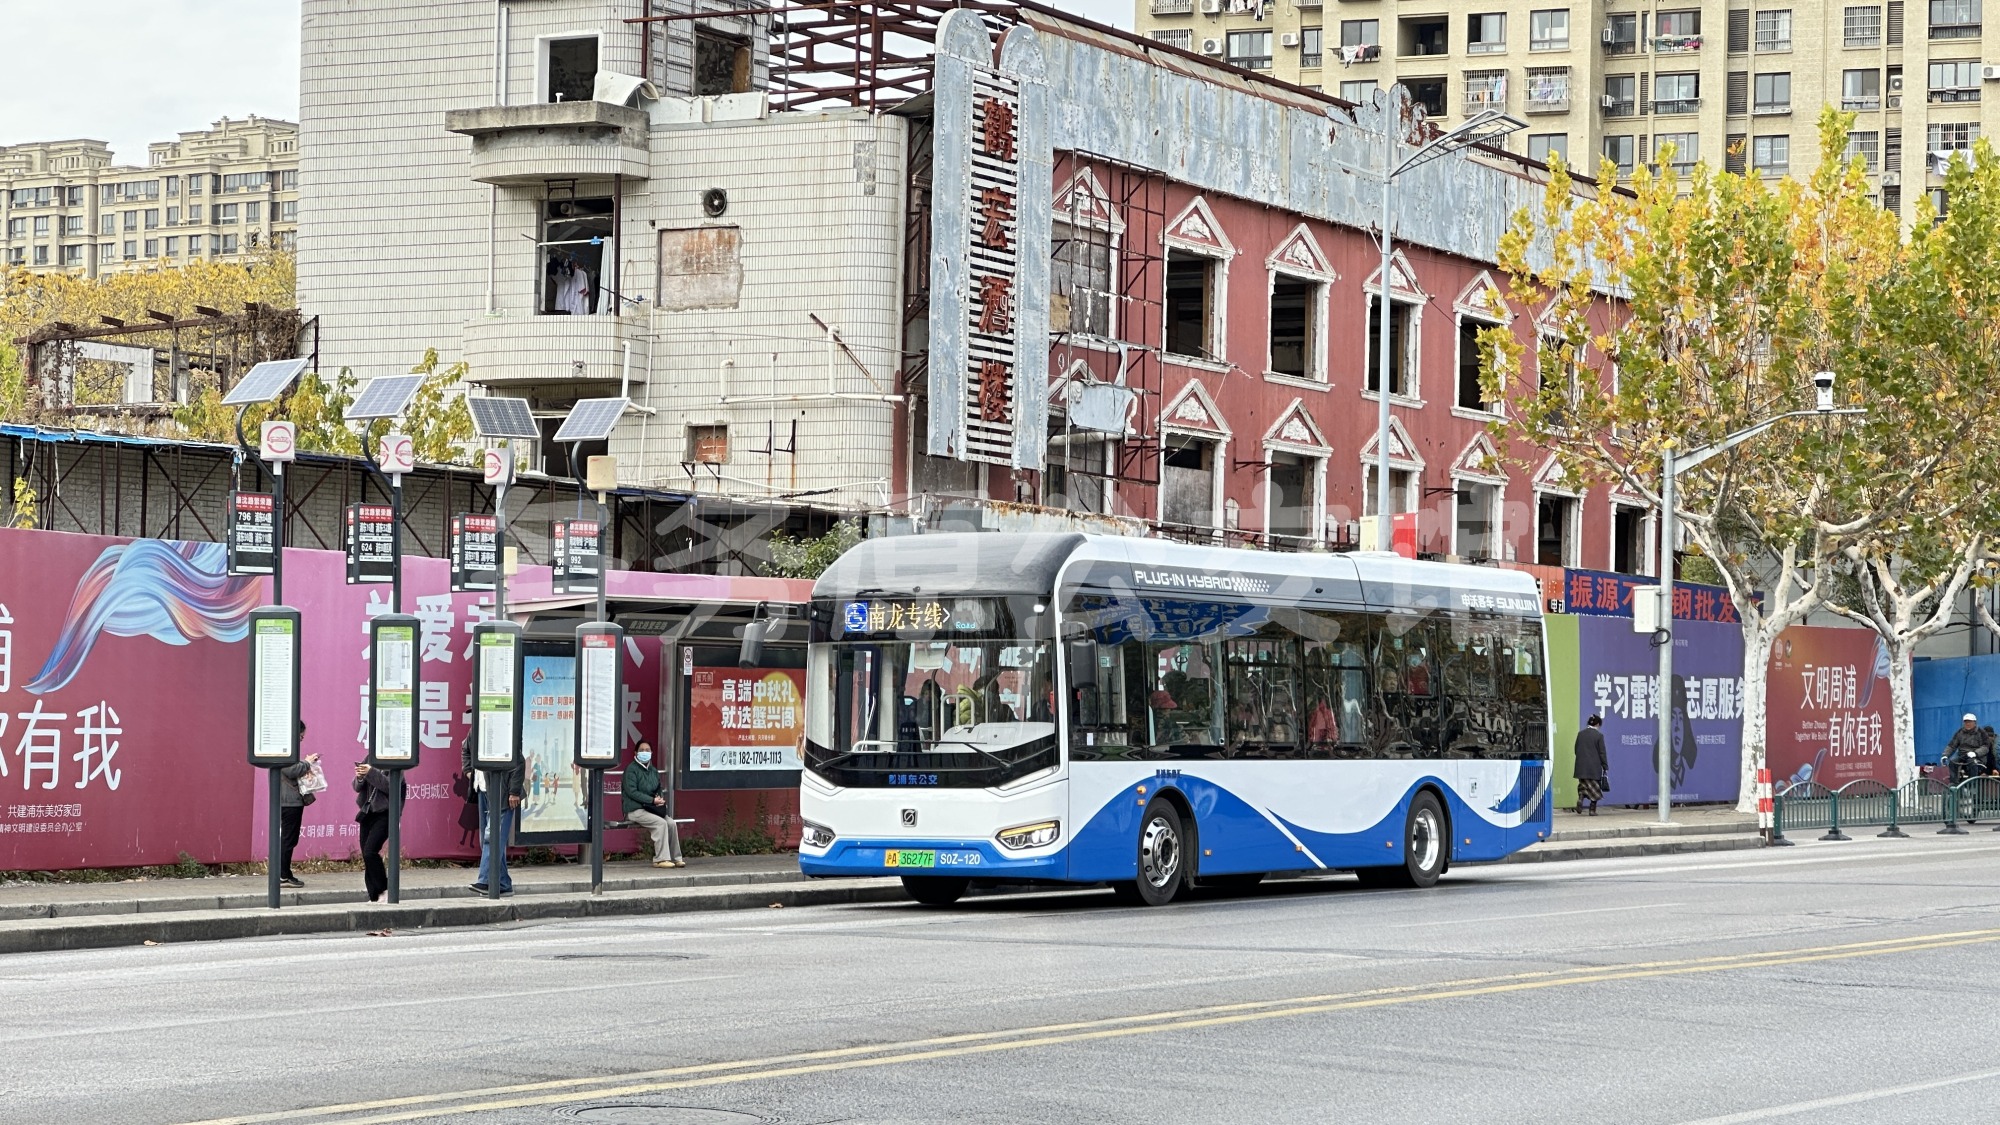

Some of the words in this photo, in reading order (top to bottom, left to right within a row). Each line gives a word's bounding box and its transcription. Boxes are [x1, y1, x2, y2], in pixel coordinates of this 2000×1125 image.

[238, 512, 251, 521] 796
[361, 543, 373, 551] 624
[570, 556, 582, 564] 992
[1187, 575, 1232, 590] HYBRID
[1461, 593, 1495, 609] 申沃客车
[1496, 597, 1538, 612] SUNWIN
[868, 602, 943, 631] 南龙专线
[722, 678, 796, 703] 高端中秋礼
[1801, 664, 1857, 710] 文明周浦
[721, 705, 796, 729] 就选蟹兴阁
[1829, 710, 1882, 757] 有你有我
[739, 751, 782, 765] 182-1704-1113
[898, 774, 938, 785] 浦东公交
[7, 803, 82, 818] 共建浦东美好家园
[299, 824, 335, 838] 文明健康
[339, 824, 360, 838] 有你
